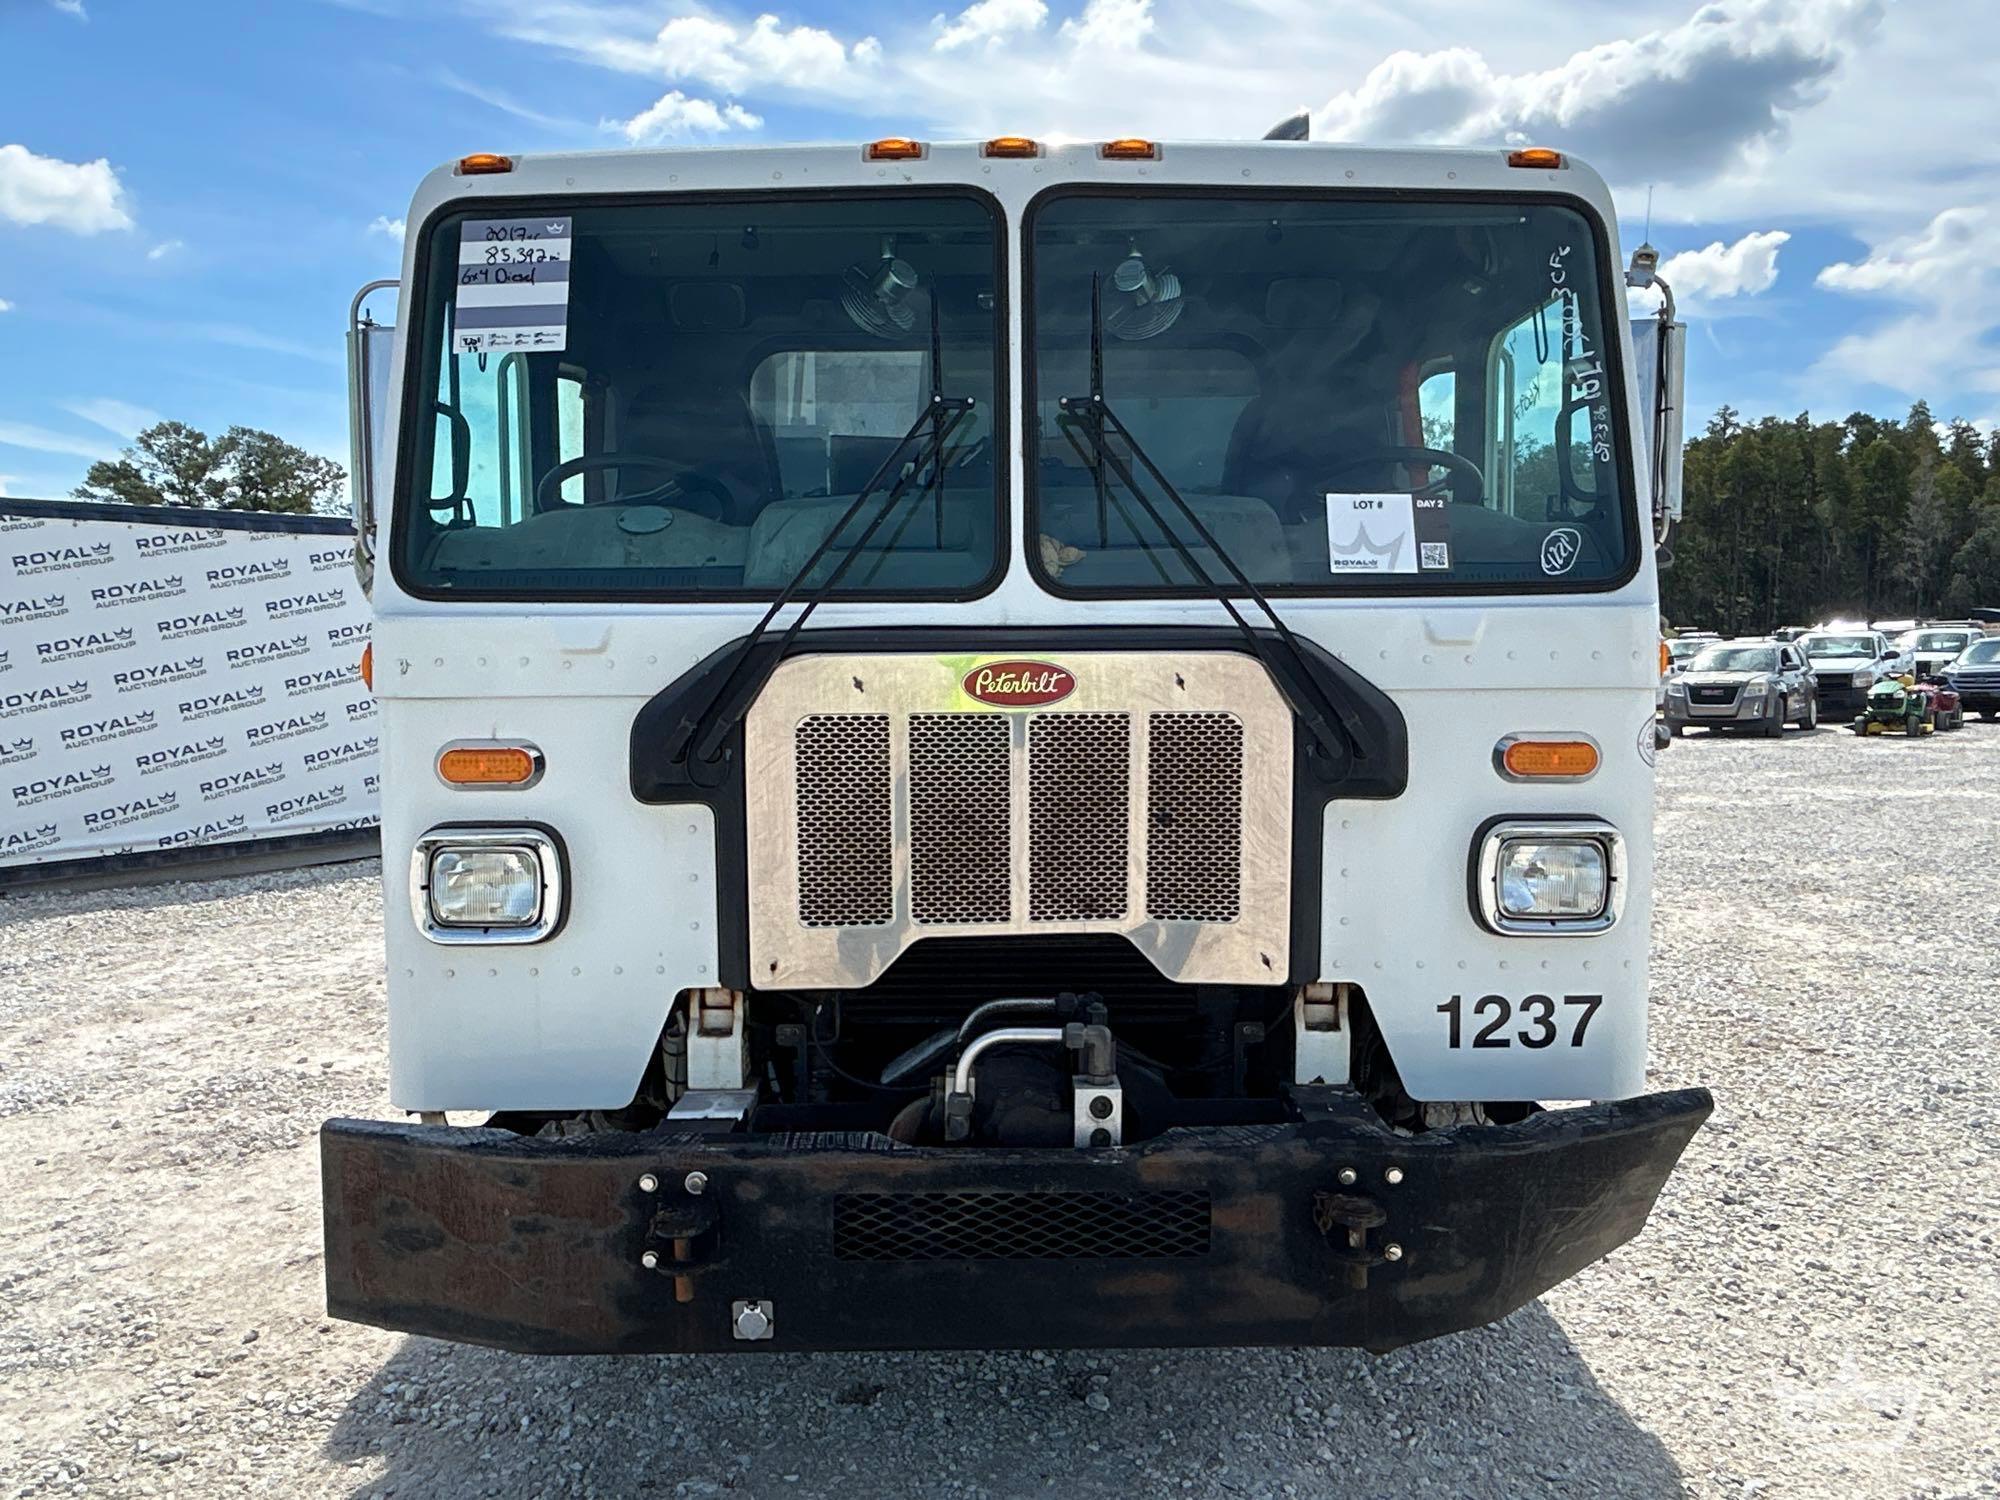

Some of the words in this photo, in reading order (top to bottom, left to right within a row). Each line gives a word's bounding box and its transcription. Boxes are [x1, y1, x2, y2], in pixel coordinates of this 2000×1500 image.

[486, 226, 526, 241] 2017
[485, 246, 546, 265] 85,392
[461, 269, 488, 284] 6x4
[1353, 500, 1373, 509] LOT
[1416, 500, 1435, 508] DAY
[1437, 500, 1444, 508] 2
[0, 520, 45, 532] GROUP
[135, 531, 206, 550] ROYAL
[140, 546, 188, 558] AUCTION
[190, 539, 227, 551] GROUP
[12, 547, 92, 569] ROYAL
[16, 563, 71, 577] AUCTION
[73, 556, 115, 569] GROUP
[312, 561, 354, 572] AUCTION
[207, 562, 273, 582] ROYAL
[210, 577, 255, 589] AUCTION
[257, 571, 291, 582] GROUP
[91, 580, 165, 601] ROYAL
[95, 594, 145, 609] AUCTION
[147, 588, 187, 601] GROUP
[0, 599, 45, 615] YAL
[266, 593, 329, 612] ROYAL
[269, 607, 312, 620] AUCTION
[314, 600, 347, 612] GROUP
[26, 608, 69, 621] GROUP
[157, 612, 227, 633] ROYAL
[161, 627, 209, 641] AUCTION
[210, 620, 247, 632] GROUP
[331, 635, 371, 647] AUCTION
[36, 633, 115, 655] ROYAL
[41, 649, 94, 664] AUCTION
[96, 640, 137, 653] GROUP
[226, 640, 292, 662] ROYAL
[230, 655, 275, 669] AUCTION
[276, 648, 311, 660] GROUP
[114, 662, 186, 685] ROYAL
[118, 677, 167, 693] AUCTION
[169, 669, 207, 682] GROUP
[285, 668, 347, 689] ROYAL
[976, 669, 1066, 695] Peterbilt
[288, 683, 330, 697] AUCTION
[0, 699, 48, 718] UCTION
[50, 694, 92, 707] GROUP
[179, 690, 247, 714] ROYAL
[182, 706, 229, 721] AUCTION
[230, 698, 266, 711] GROUP
[60, 716, 137, 741] ROYAL
[64, 733, 117, 750] AUCTION
[119, 723, 158, 737] GROUP
[247, 716, 311, 739] ROYAL
[250, 732, 293, 747] AUCTION
[295, 722, 329, 735] GROUP
[0, 752, 37, 766] ROUP
[136, 742, 207, 768] ROYAL
[140, 758, 188, 776] AUCTION
[190, 749, 227, 762] GROUP
[304, 742, 365, 765] ROYAL
[307, 757, 348, 772] AUCTION
[12, 771, 92, 799] ROYAL
[200, 768, 267, 793] ROYAL
[203, 784, 249, 801] AUCTION
[251, 774, 286, 788] GROUP
[16, 789, 72, 808] AUCTION
[73, 777, 115, 793] GROUP
[83, 798, 159, 826] ROYAL
[266, 792, 329, 816] ROYAL
[270, 807, 312, 824] AUCTION
[314, 796, 347, 810] GROUP
[88, 815, 139, 833] AUCTION
[141, 803, 180, 818] GROUP
[158, 821, 228, 847] ROYAL
[210, 826, 248, 840] GROUP
[18, 837, 61, 853] GROUP
[1437, 994, 1603, 1049] 1237
